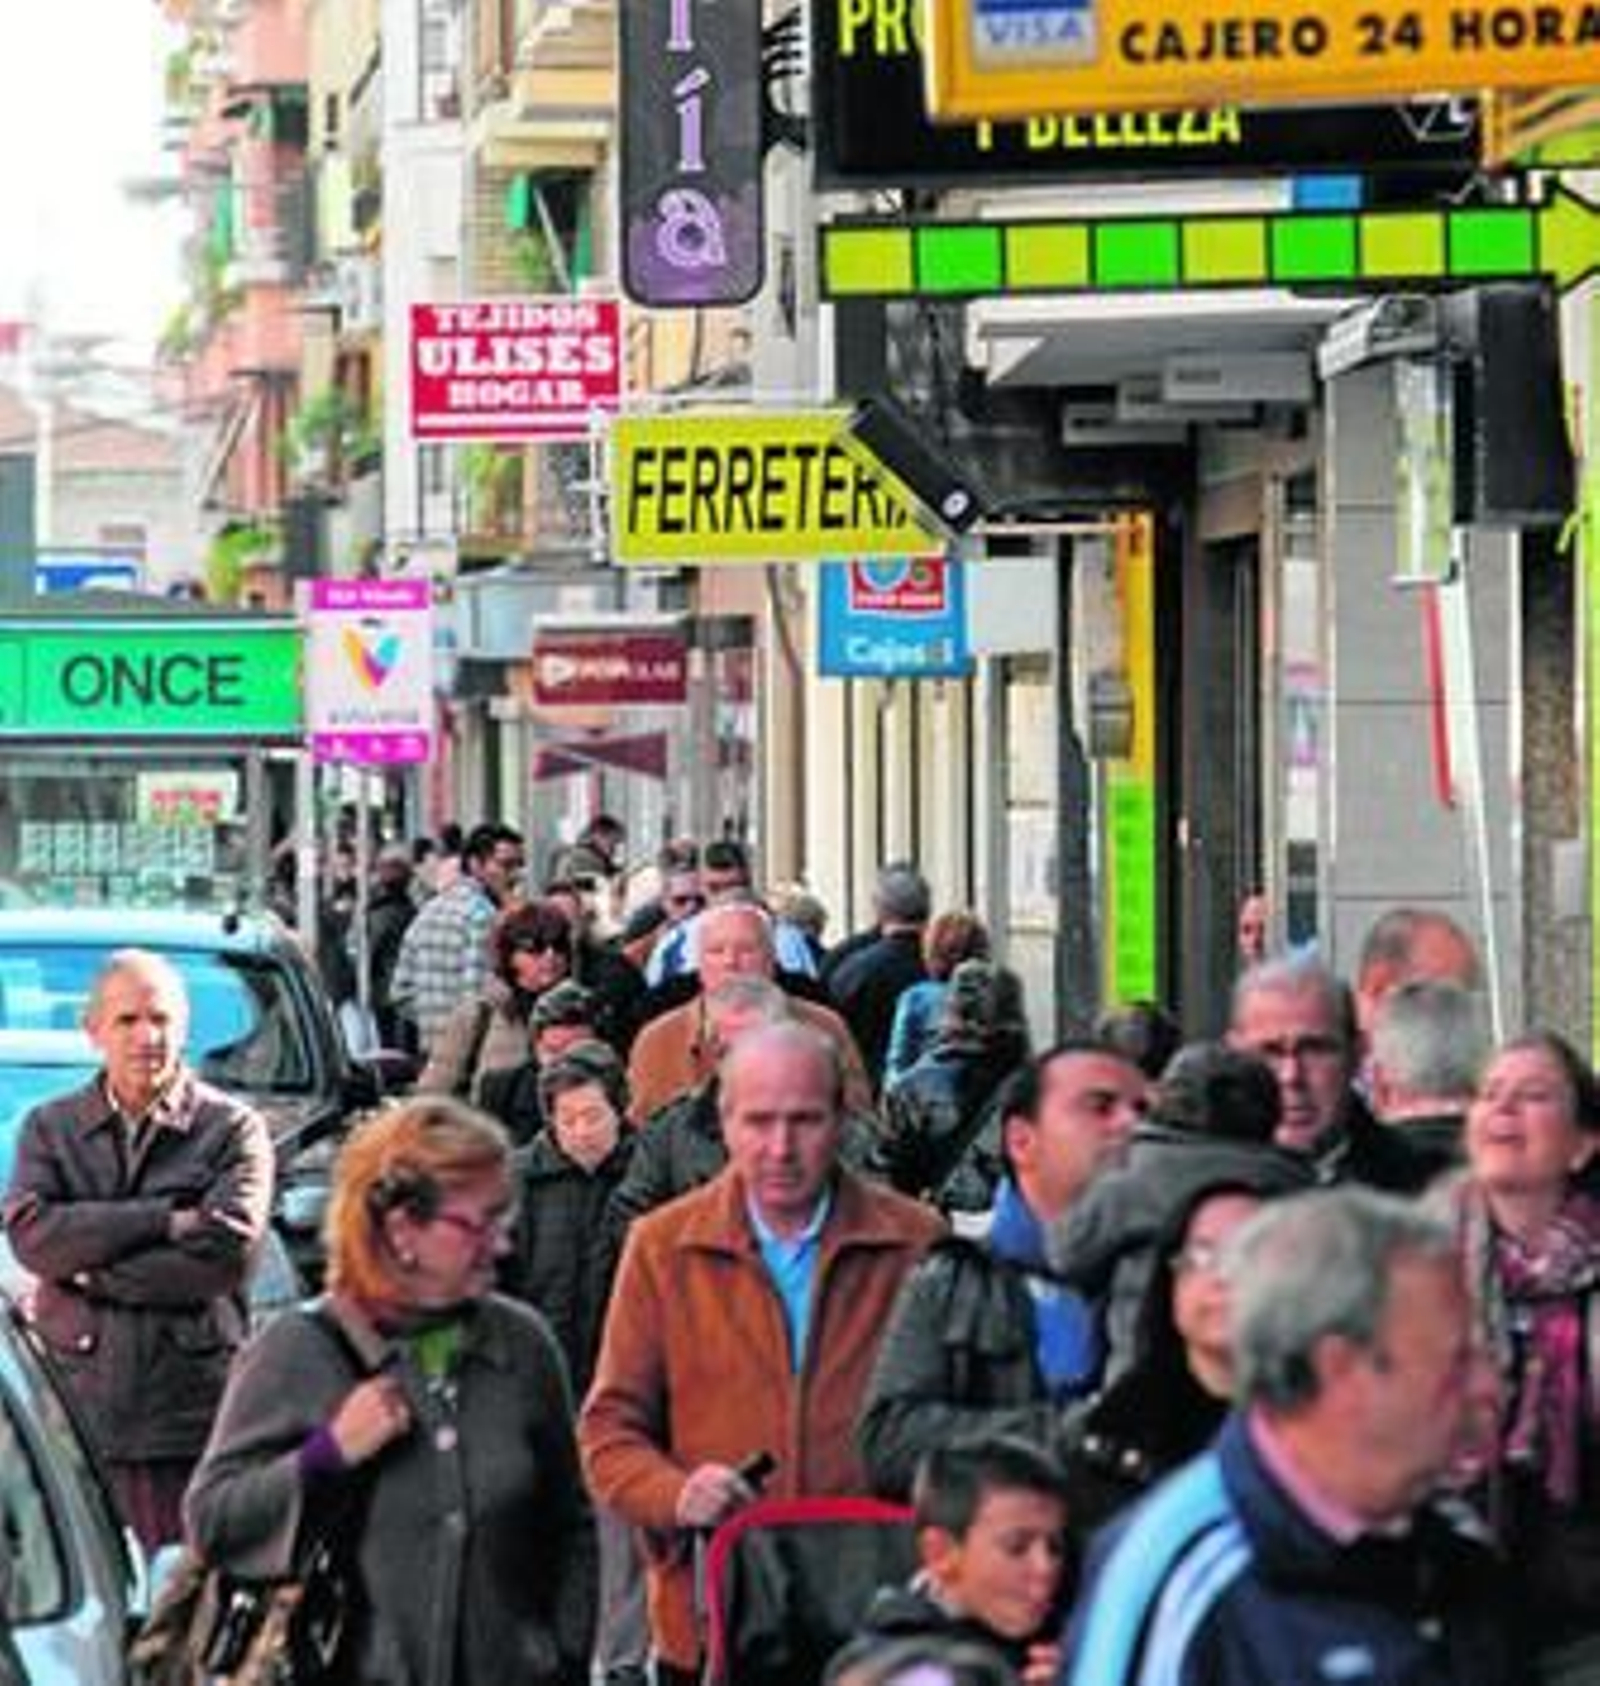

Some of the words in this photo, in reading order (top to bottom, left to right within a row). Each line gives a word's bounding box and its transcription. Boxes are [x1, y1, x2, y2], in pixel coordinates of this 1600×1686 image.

[984, 14, 1081, 45] VISA
[1119, 16, 1329, 63] CAJERO
[1356, 12, 1424, 54] 24
[434, 303, 598, 331] TEJIDOS
[417, 335, 615, 377] ULISES
[447, 379, 586, 408] HOGAR
[628, 445, 908, 534] FERRETER
[60, 652, 245, 707] ONCE
